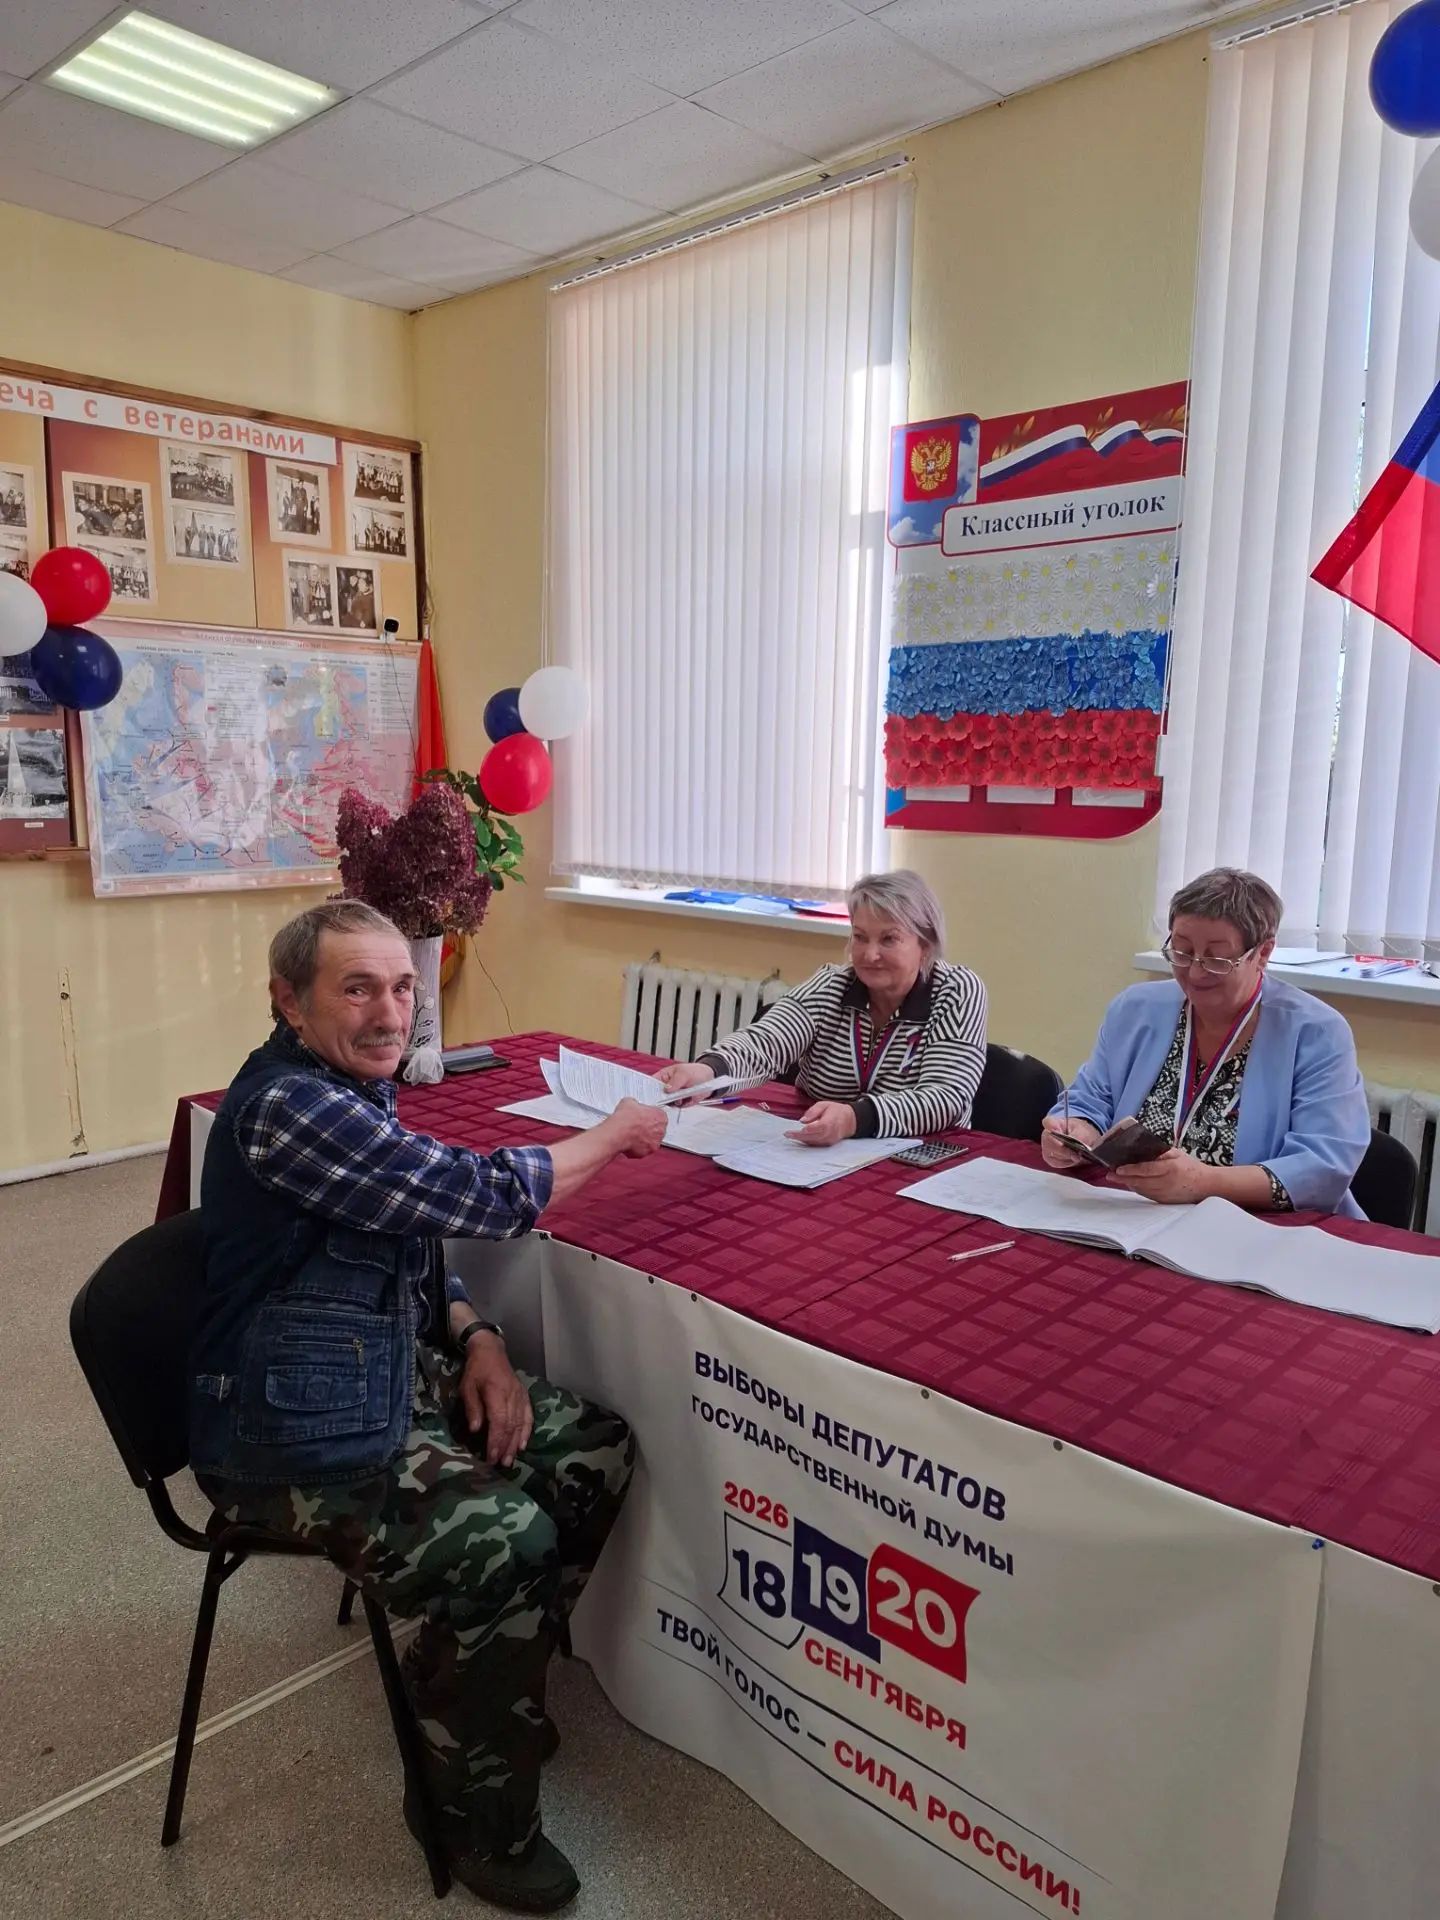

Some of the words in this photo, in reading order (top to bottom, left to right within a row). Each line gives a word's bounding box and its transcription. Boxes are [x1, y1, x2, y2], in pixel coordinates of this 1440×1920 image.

[84, 399, 98, 418] с
[125, 406, 305, 454] ветеранами
[961, 502, 1075, 537] Классный
[1082, 495, 1166, 528] уголок
[691, 1394, 917, 1530] ГОСУДАРСТВЕННОЙ
[923, 1516, 1014, 1576] ДУМЫ
[695, 1351, 805, 1428] ВЫБОРЫ
[812, 1411, 1006, 1522] ДЕПУТАТОВ
[723, 1480, 789, 1529] 2026
[732, 1549, 787, 1619] 18
[801, 1552, 860, 1625] 19
[875, 1567, 957, 1649] 20
[804, 1638, 967, 1750] СЕНТЯБРЯ
[657, 1608, 721, 1667] ТВОЙ
[724, 1654, 800, 1734] ГОЛОС
[834, 1740, 918, 1811] СИЛА
[927, 1795, 1080, 1916] РОССИИ!
